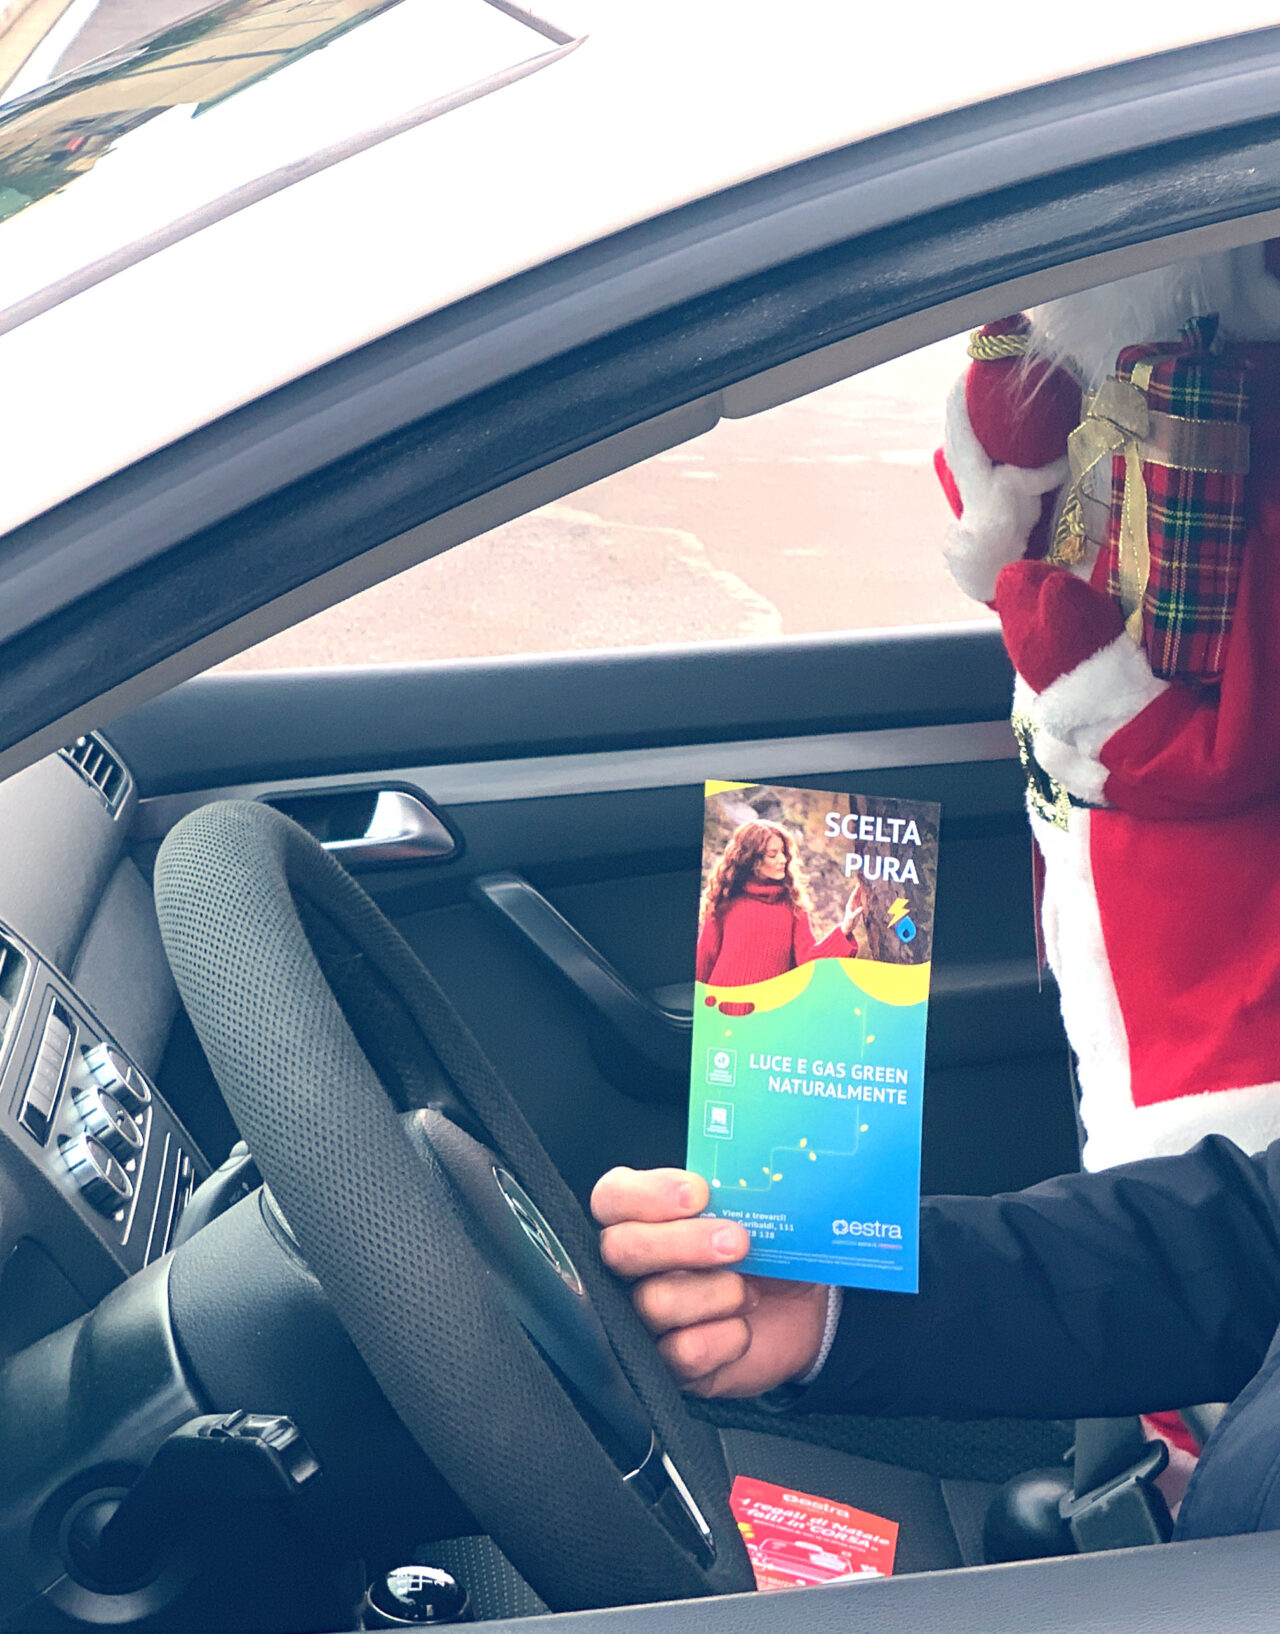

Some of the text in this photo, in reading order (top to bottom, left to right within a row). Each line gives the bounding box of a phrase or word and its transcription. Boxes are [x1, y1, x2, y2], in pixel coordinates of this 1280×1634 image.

[824, 812, 922, 846] SCELTA
[844, 852, 920, 885] PURA
[749, 1053, 909, 1085] LUCE E GAS GREEN
[768, 1076, 908, 1105] NATURALMENTE
[722, 1209, 744, 1219] Vieni
[745, 1211, 751, 1219] a
[779, 1222, 795, 1232] 111
[849, 1219, 903, 1240] estra
[799, 1497, 850, 1519] estra
[753, 1502, 808, 1521] regali
[831, 1521, 890, 1547] Natale
